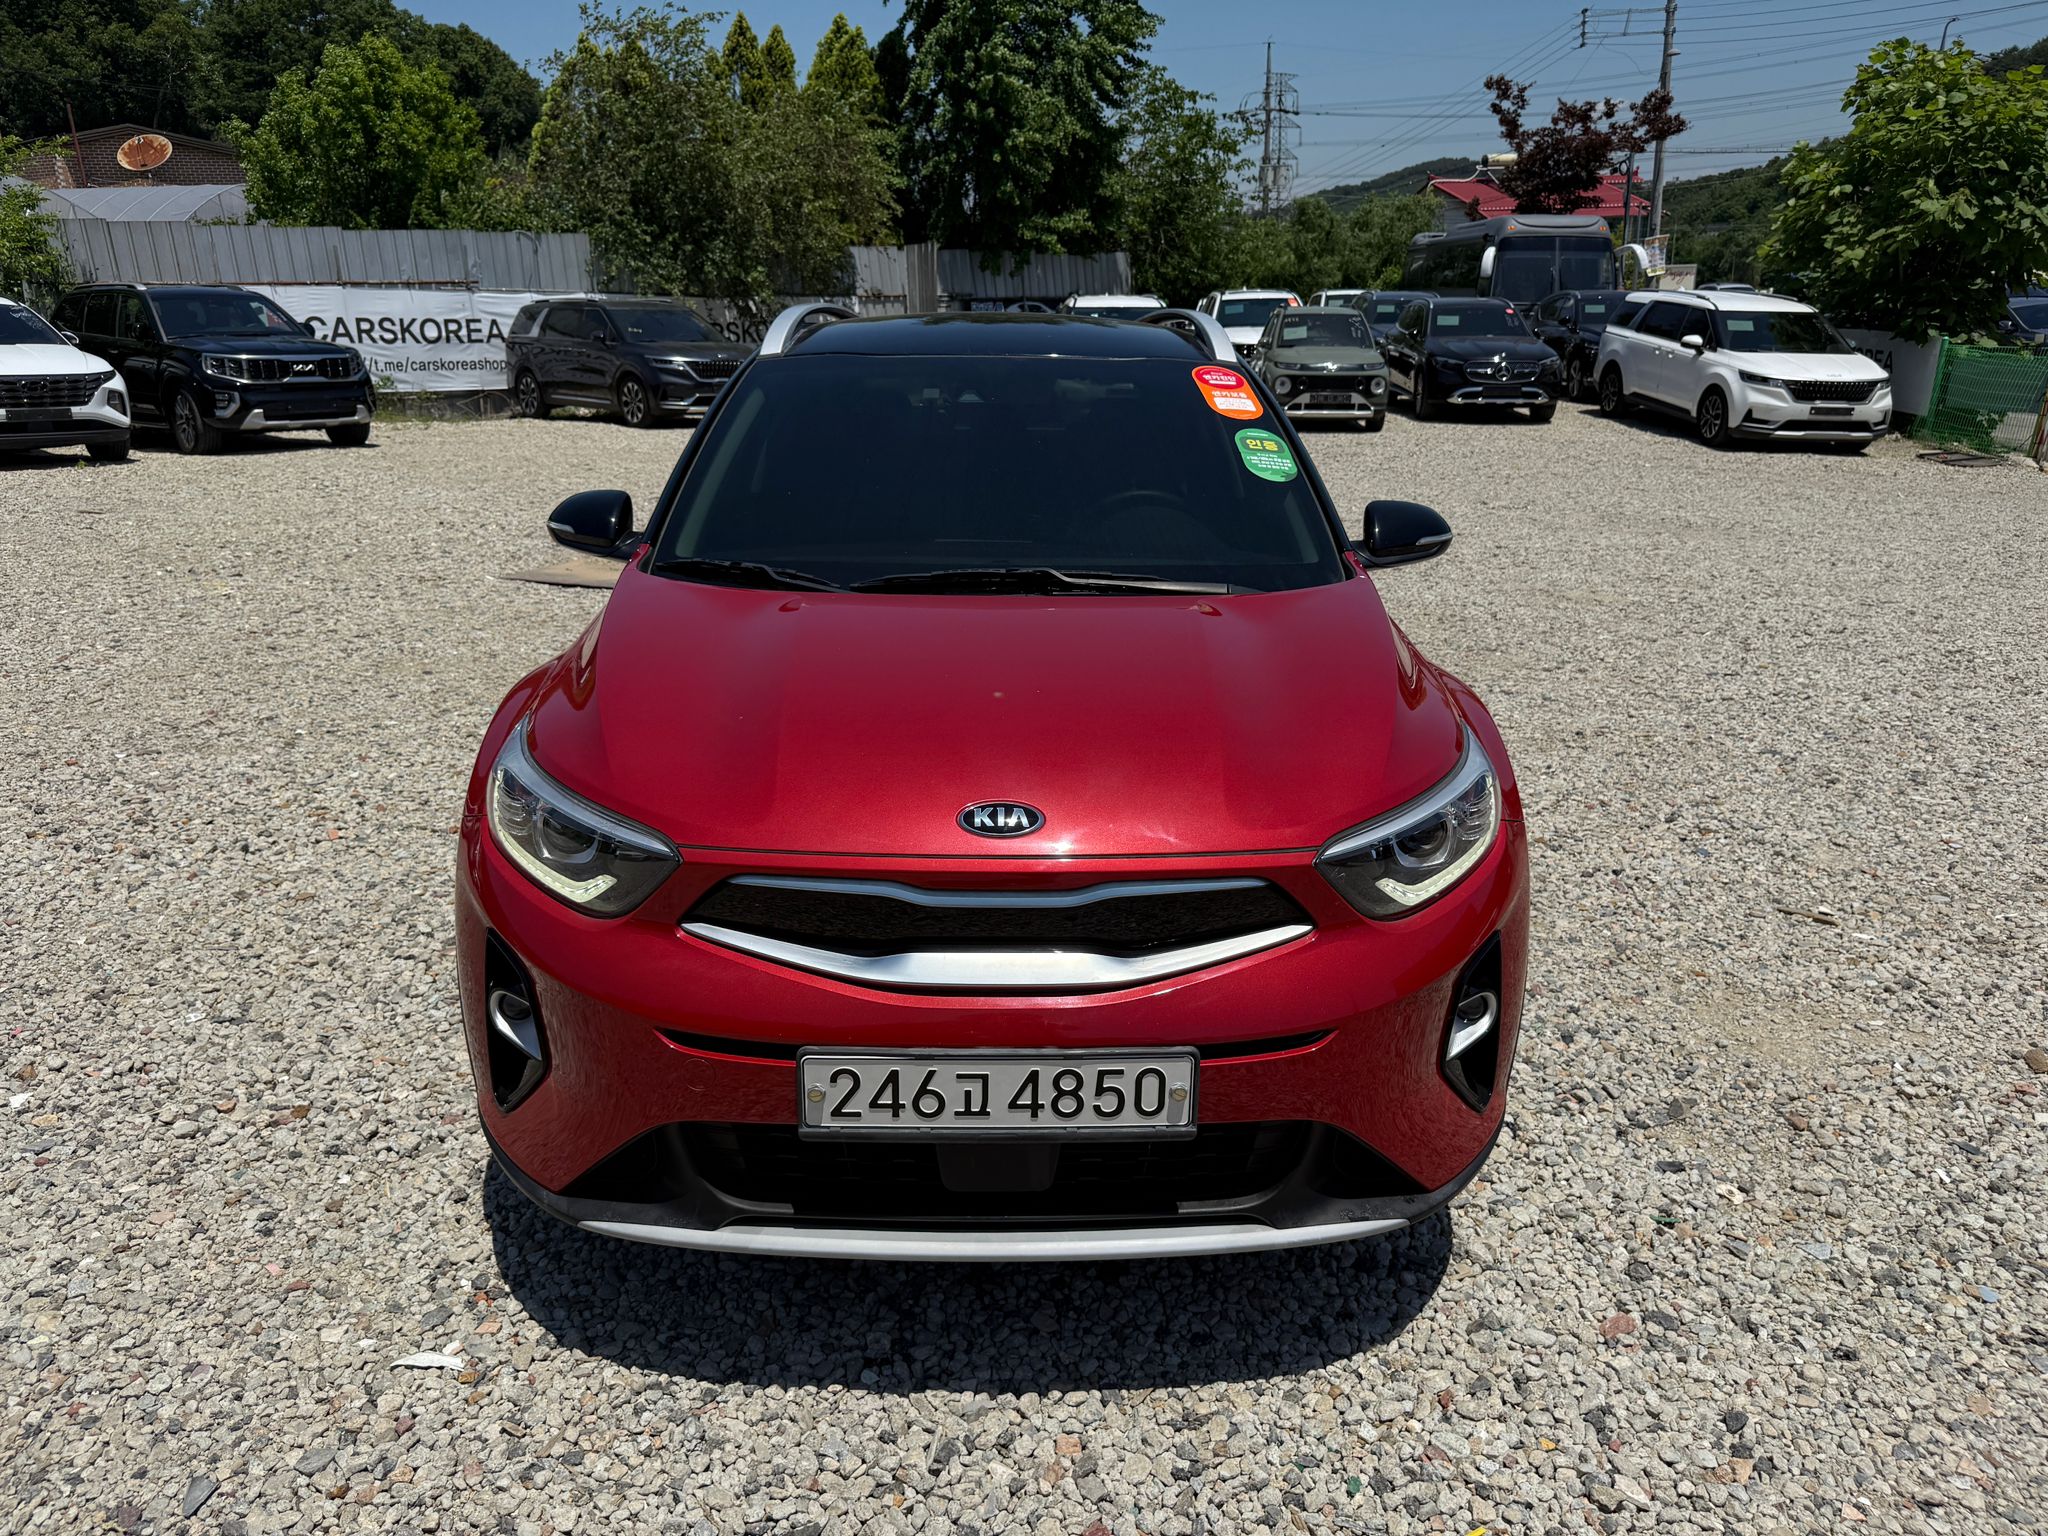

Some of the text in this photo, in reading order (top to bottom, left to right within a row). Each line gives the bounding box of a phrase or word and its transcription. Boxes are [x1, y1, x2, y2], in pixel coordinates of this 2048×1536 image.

[305, 316, 506, 344] CARSKOREA
[1245, 439, 1279, 452] 인증
[973, 806, 1030, 828] KIA
[829, 1065, 1167, 1119] 246고 4850
